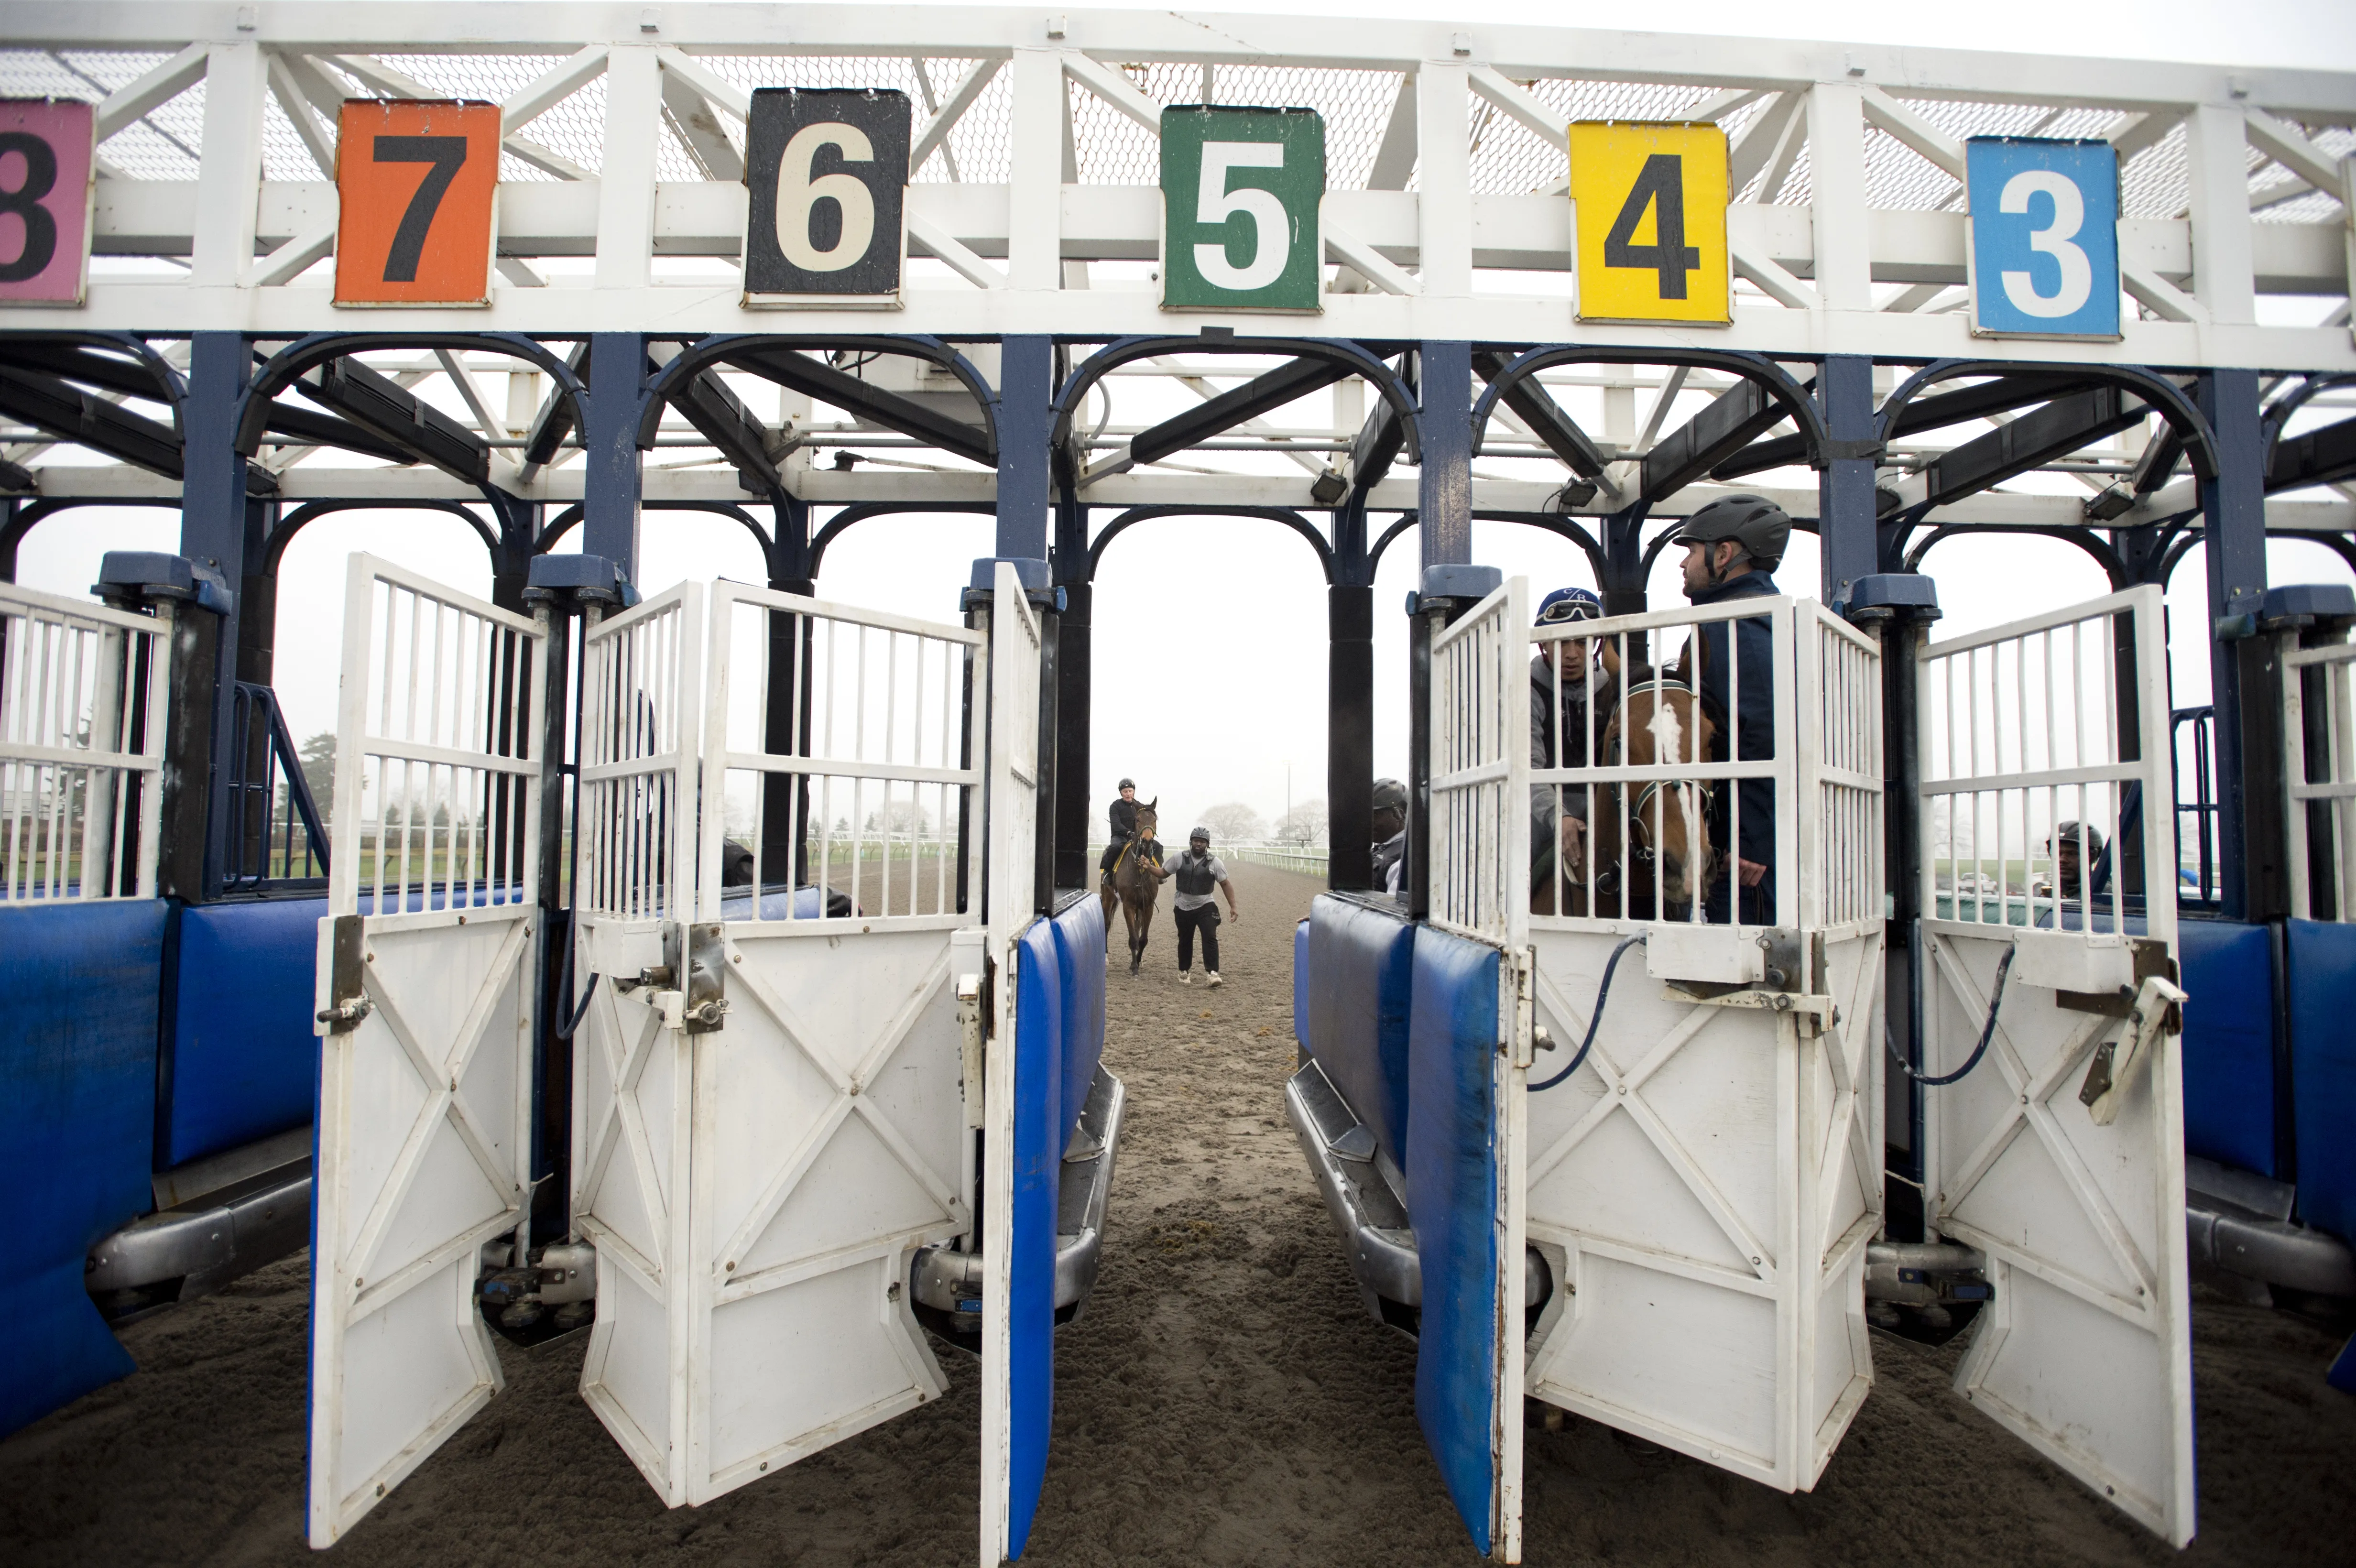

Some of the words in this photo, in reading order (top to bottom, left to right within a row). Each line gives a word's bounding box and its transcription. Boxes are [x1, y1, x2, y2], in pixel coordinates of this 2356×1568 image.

[0, 131, 57, 283] 8
[373, 136, 467, 282] 7
[776, 123, 874, 272] 6
[1194, 142, 1288, 290] 5
[1604, 154, 1700, 299] 4
[2000, 171, 2091, 317] 3
